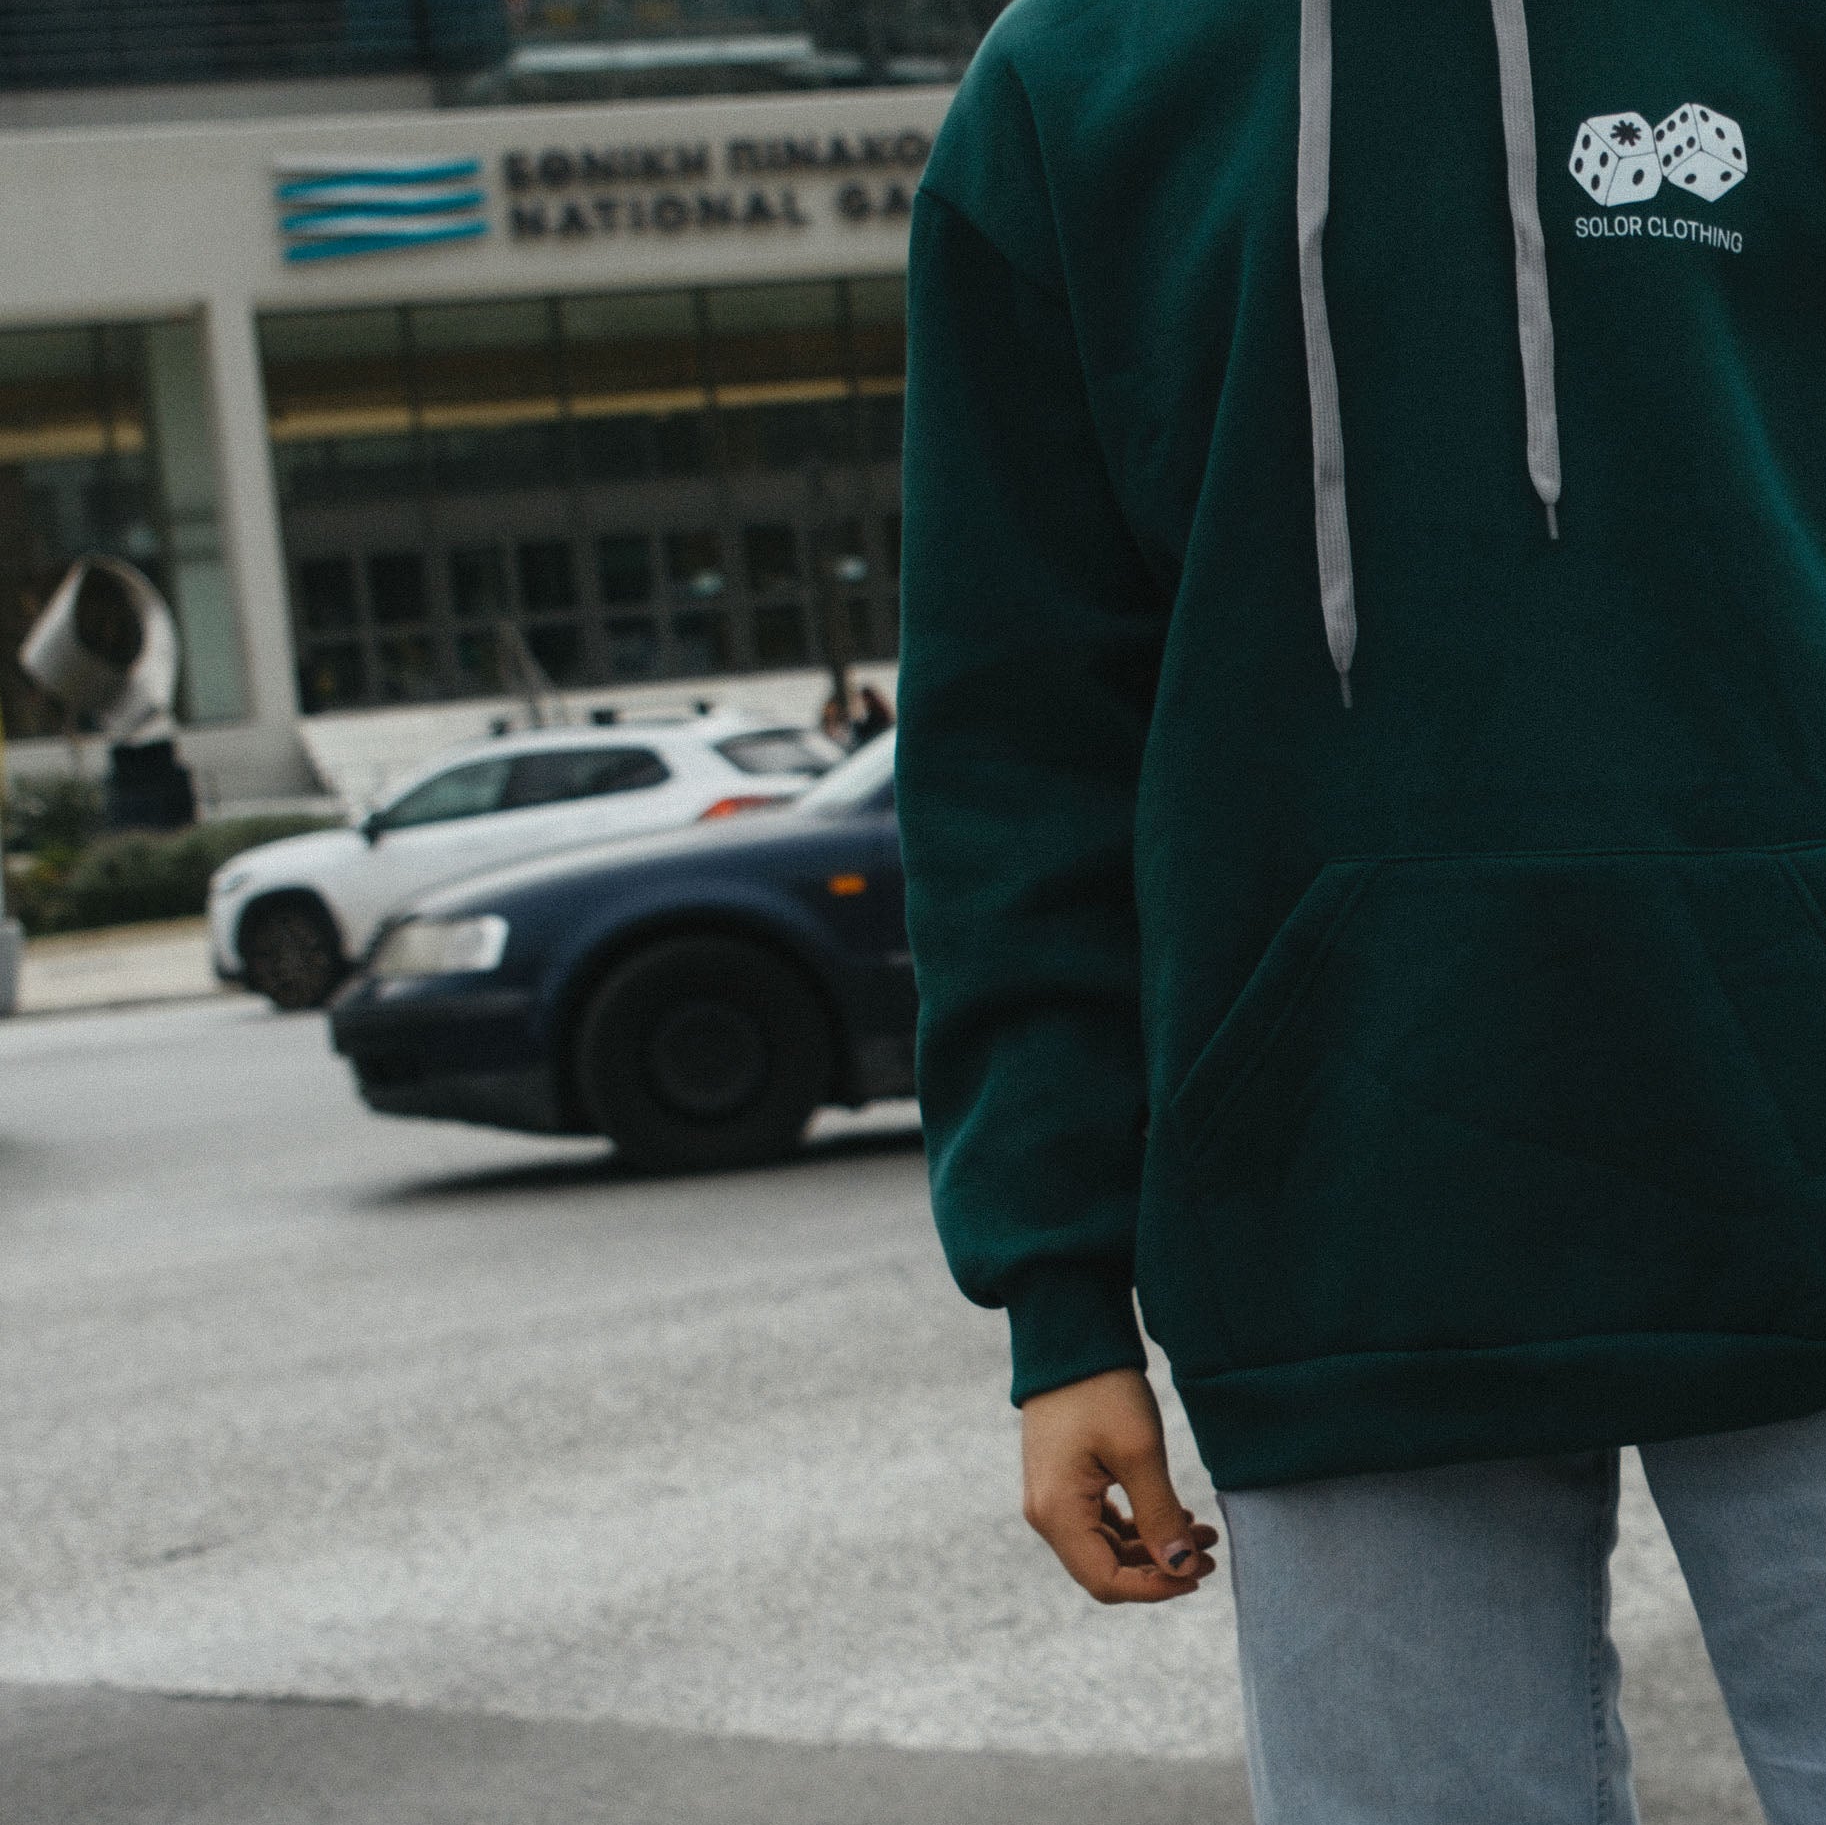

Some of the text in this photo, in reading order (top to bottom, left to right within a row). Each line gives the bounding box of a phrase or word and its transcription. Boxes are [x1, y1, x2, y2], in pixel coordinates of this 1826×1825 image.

[511, 185, 811, 238] NATIONAL
[1575, 216, 1743, 254] SOLOR CLOTHING
